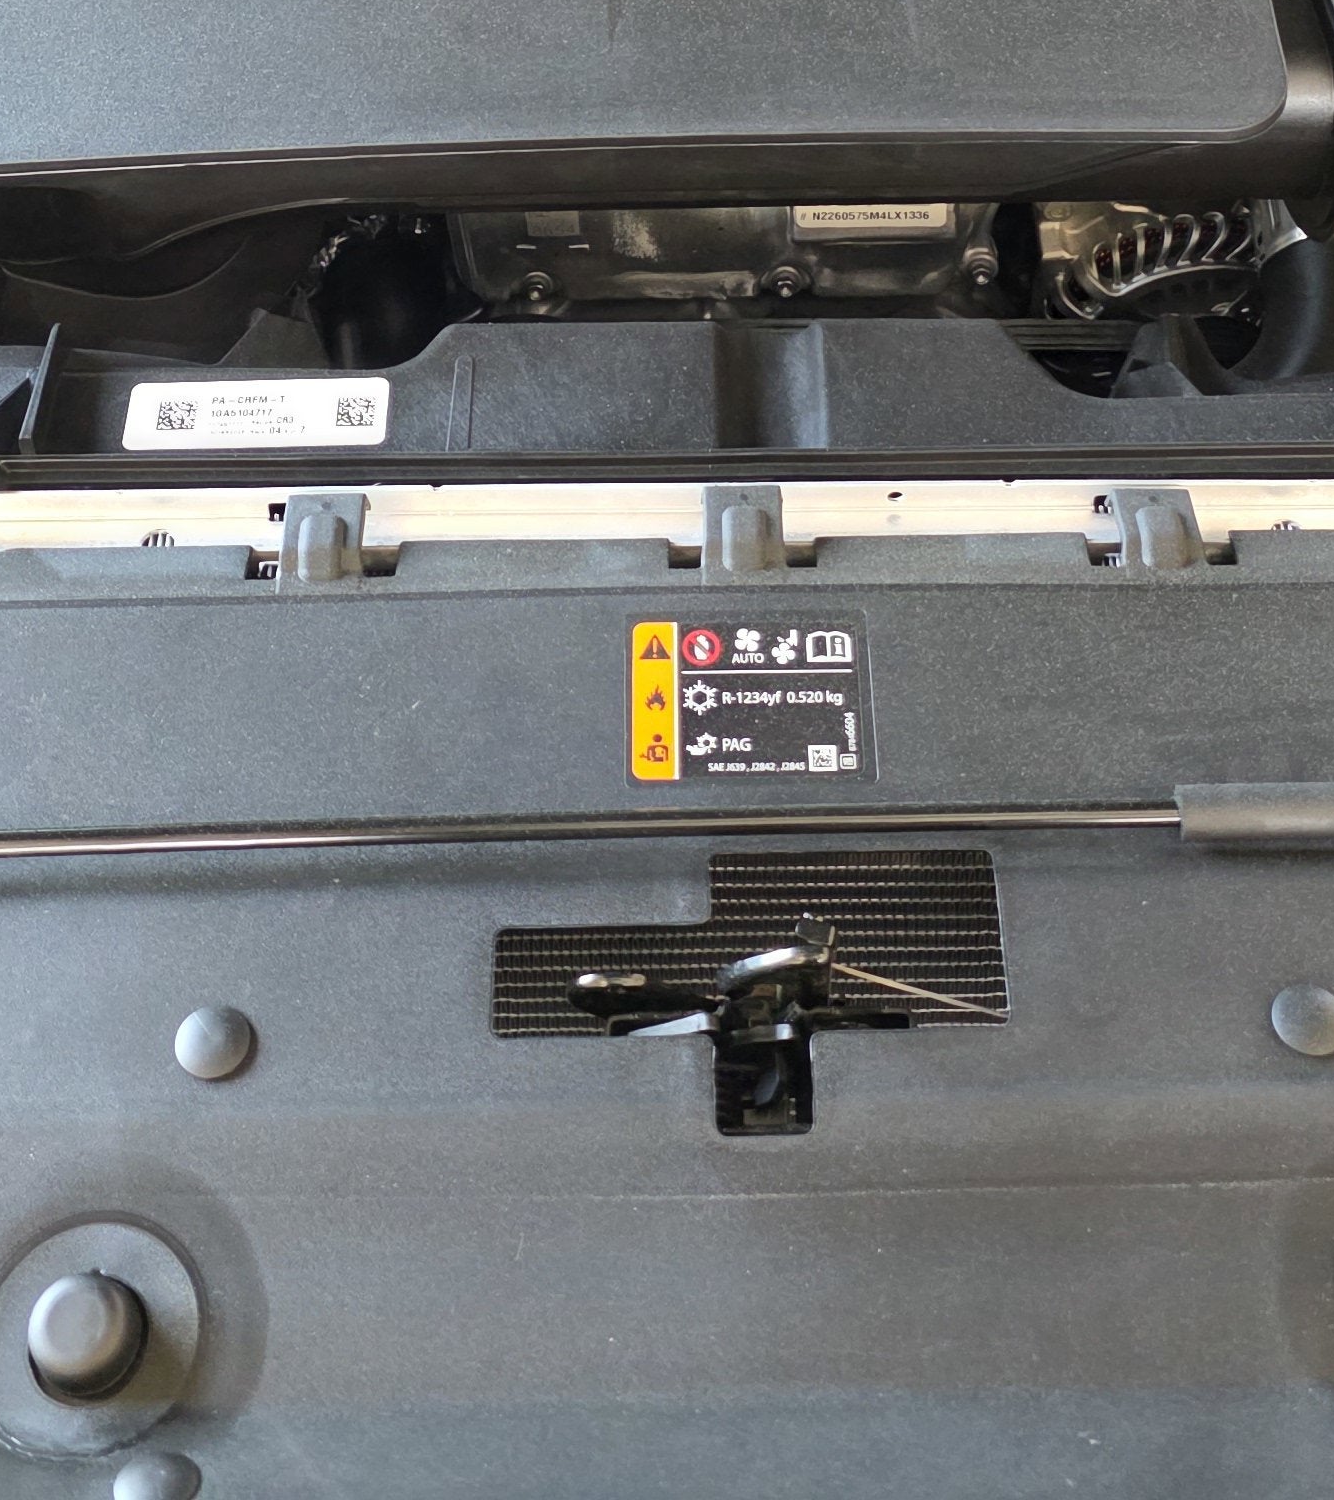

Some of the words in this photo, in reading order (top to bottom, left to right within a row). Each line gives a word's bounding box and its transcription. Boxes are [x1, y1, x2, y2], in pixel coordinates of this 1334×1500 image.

[813, 211, 930, 221] N2260575M4LX1336
[732, 652, 764, 664] AUTO
[722, 689, 782, 706] R-1234yf
[787, 689, 823, 704] 0.520
[825, 689, 843, 706] kg
[722, 737, 752, 751] PAG
[708, 762, 724, 772] SAE
